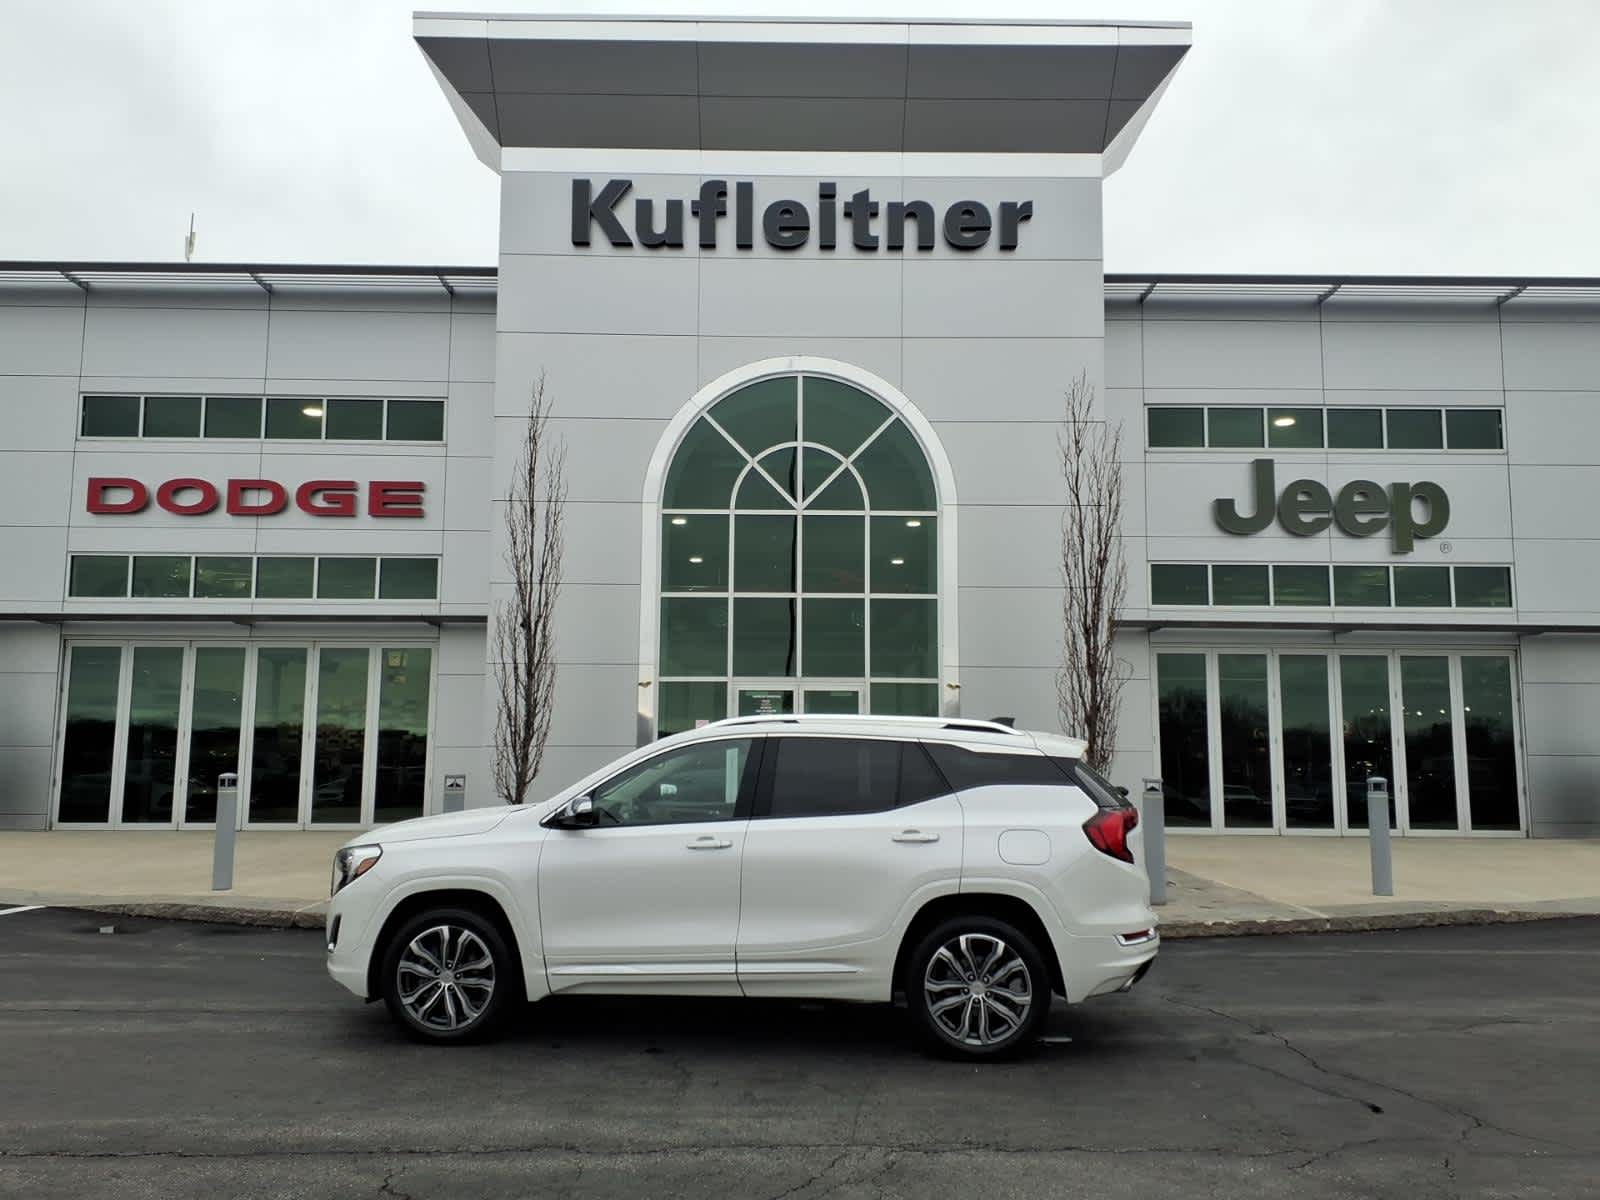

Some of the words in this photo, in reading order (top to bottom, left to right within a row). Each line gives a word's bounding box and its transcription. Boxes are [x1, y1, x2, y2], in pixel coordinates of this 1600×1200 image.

[571, 178, 1033, 251] Kufleitner
[86, 477, 425, 517] DODGE
[1213, 458, 1450, 554] Jeep
